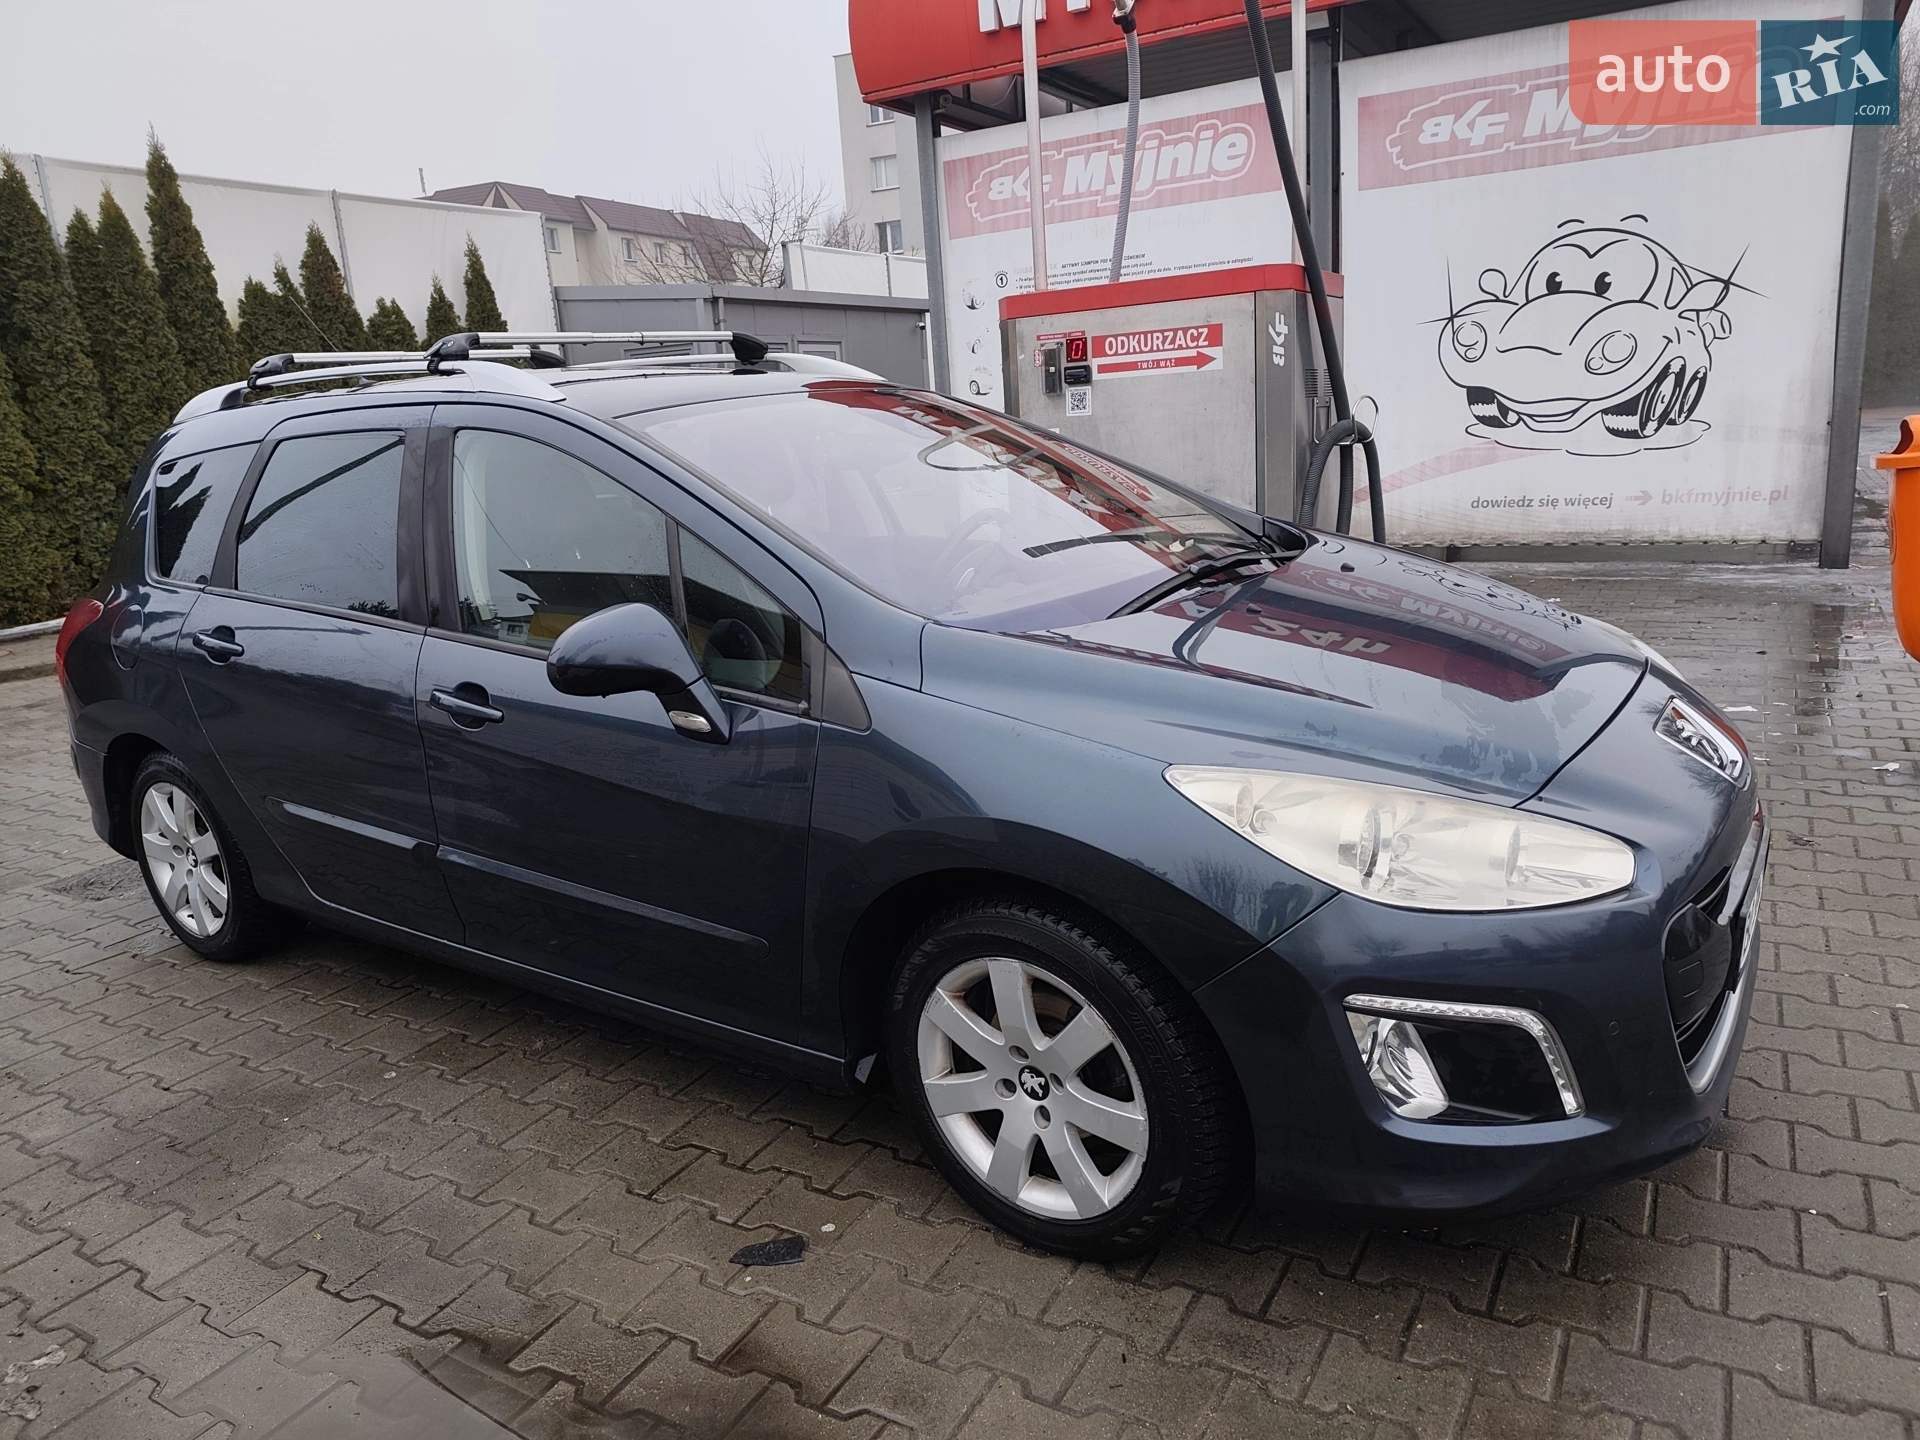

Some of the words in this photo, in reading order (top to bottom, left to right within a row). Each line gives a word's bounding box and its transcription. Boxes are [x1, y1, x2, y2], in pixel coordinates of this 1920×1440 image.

[1418, 97, 1510, 147] BKF
[1104, 327, 1209, 355] ODKURZACZ
[1268, 311, 1289, 367] BKF
[1137, 360, 1157, 369] TWÓJ
[1159, 358, 1176, 369] WĄŻ
[1470, 494, 1534, 509] dowiedz
[1538, 494, 1559, 510] się
[1564, 492, 1614, 509] więcej
[1660, 485, 1789, 506] bkfmyjnie.pl
